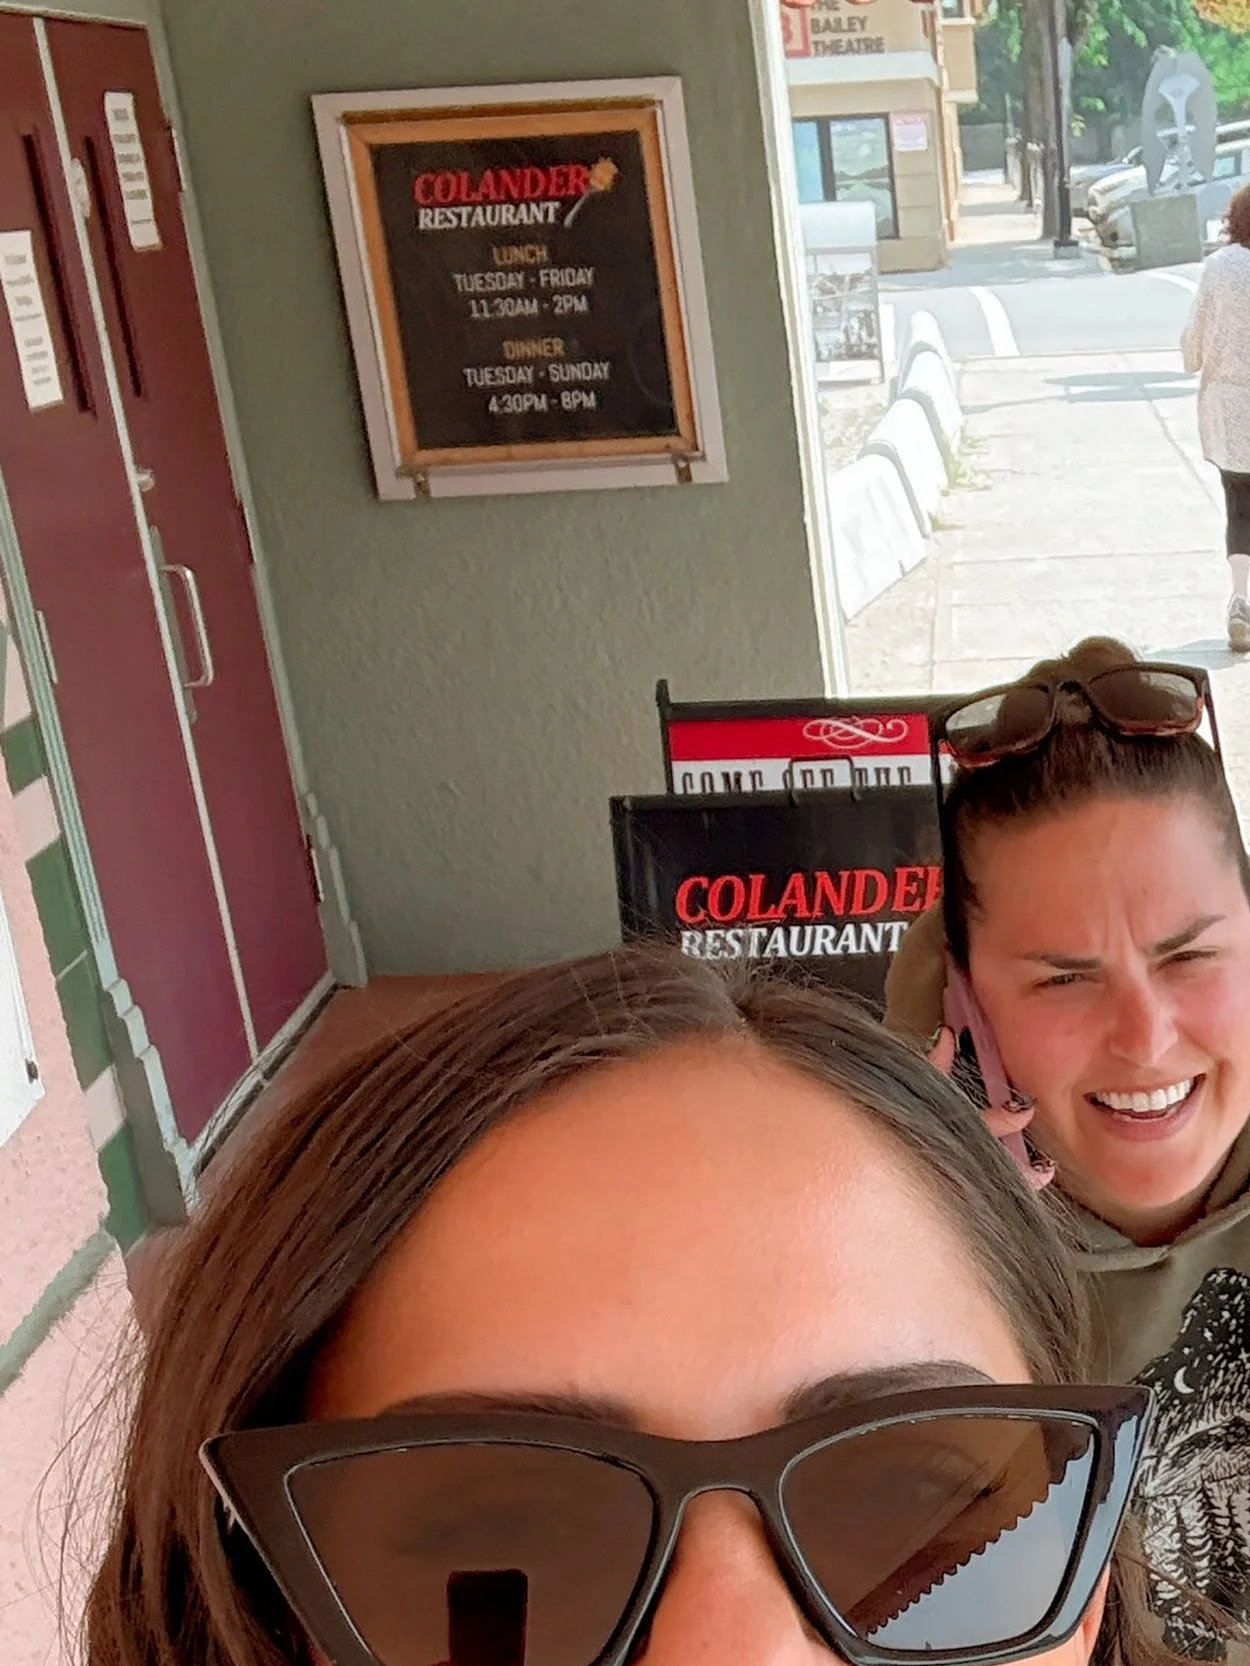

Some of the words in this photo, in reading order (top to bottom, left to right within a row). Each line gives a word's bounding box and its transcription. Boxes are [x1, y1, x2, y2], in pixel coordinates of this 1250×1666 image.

[811, 15, 867, 34] BAILEY
[812, 36, 885, 57] THEATRE
[414, 164, 590, 205] COLANDER
[418, 201, 561, 229] RESTAURANT
[493, 243, 548, 265] LUNCH
[453, 270, 525, 292] TUESDAY
[538, 267, 596, 288] FRIDAY
[551, 294, 588, 314] 2PM
[502, 337, 565, 360] DINNER
[462, 366, 535, 388] TUESDAY
[547, 361, 611, 383] SUNDAY
[560, 390, 598, 411] 8PM
[680, 920, 909, 960] RESTAURANT
